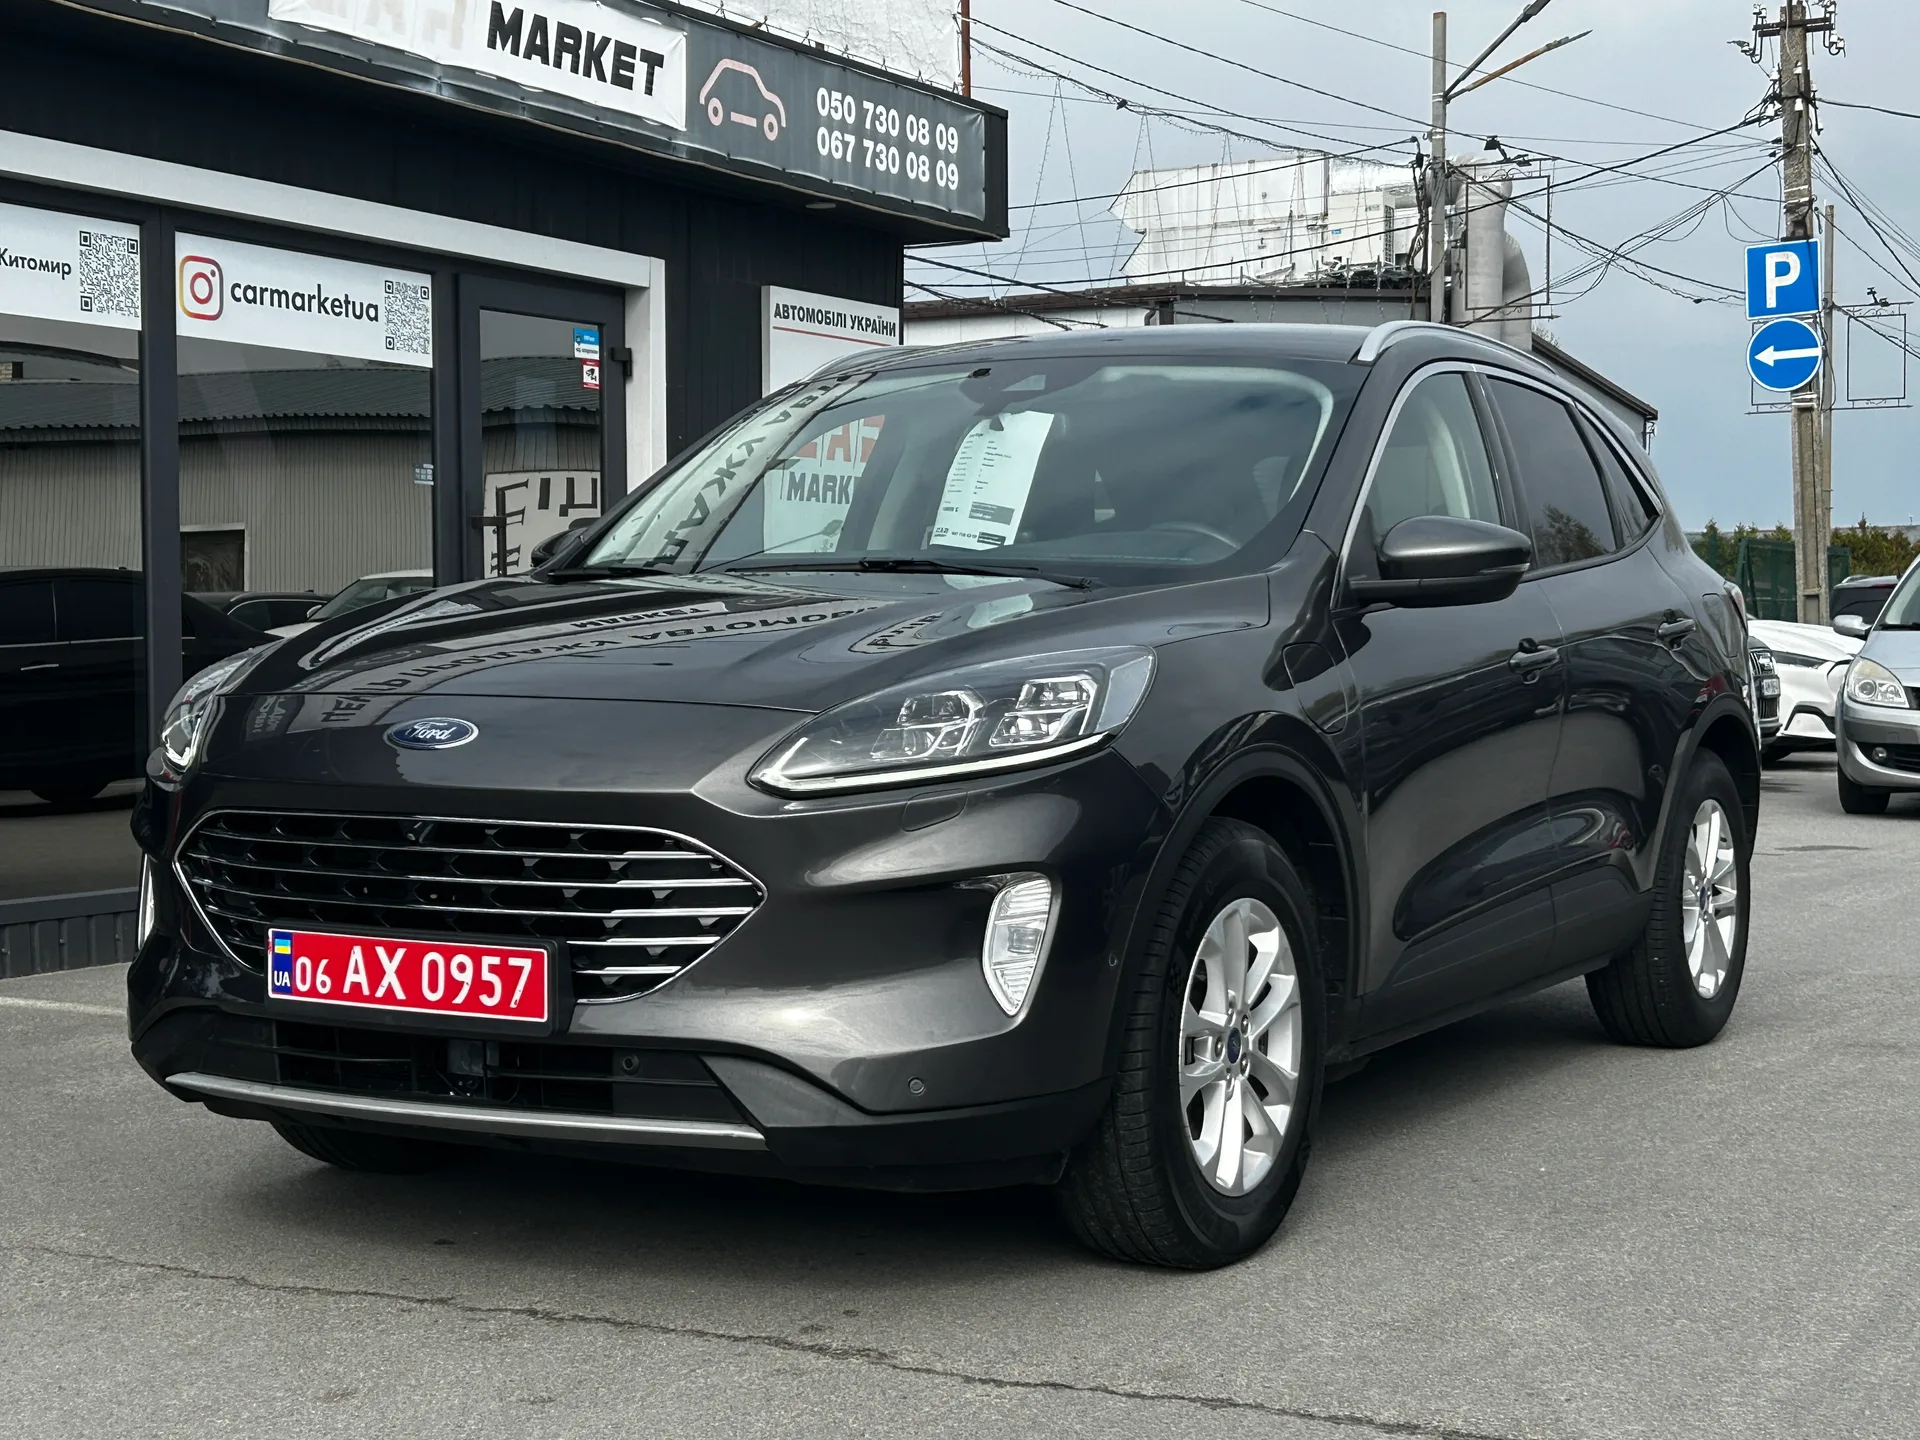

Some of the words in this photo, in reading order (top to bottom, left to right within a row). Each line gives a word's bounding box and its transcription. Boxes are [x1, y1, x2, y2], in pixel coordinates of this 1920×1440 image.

[487, 0, 665, 97] MARKET
[816, 87, 856, 125] 050
[862, 100, 900, 137] 730
[905, 114, 930, 146] 08
[935, 123, 958, 154] 09
[816, 126, 855, 163] 067
[862, 139, 900, 175] 730
[905, 151, 930, 183] 08
[935, 159, 959, 191] 09
[230, 279, 380, 323] carmarketua
[1764, 251, 1801, 309] P
[773, 303, 847, 329] АВТОМОБІЛІ
[849, 315, 897, 338] УКРАЇНИ
[786, 471, 858, 504] MARK
[405, 721, 456, 740] Ford
[274, 970, 291, 987] UA
[295, 956, 332, 994] 06
[342, 945, 407, 1000] AX
[421, 952, 533, 1008] 0957
